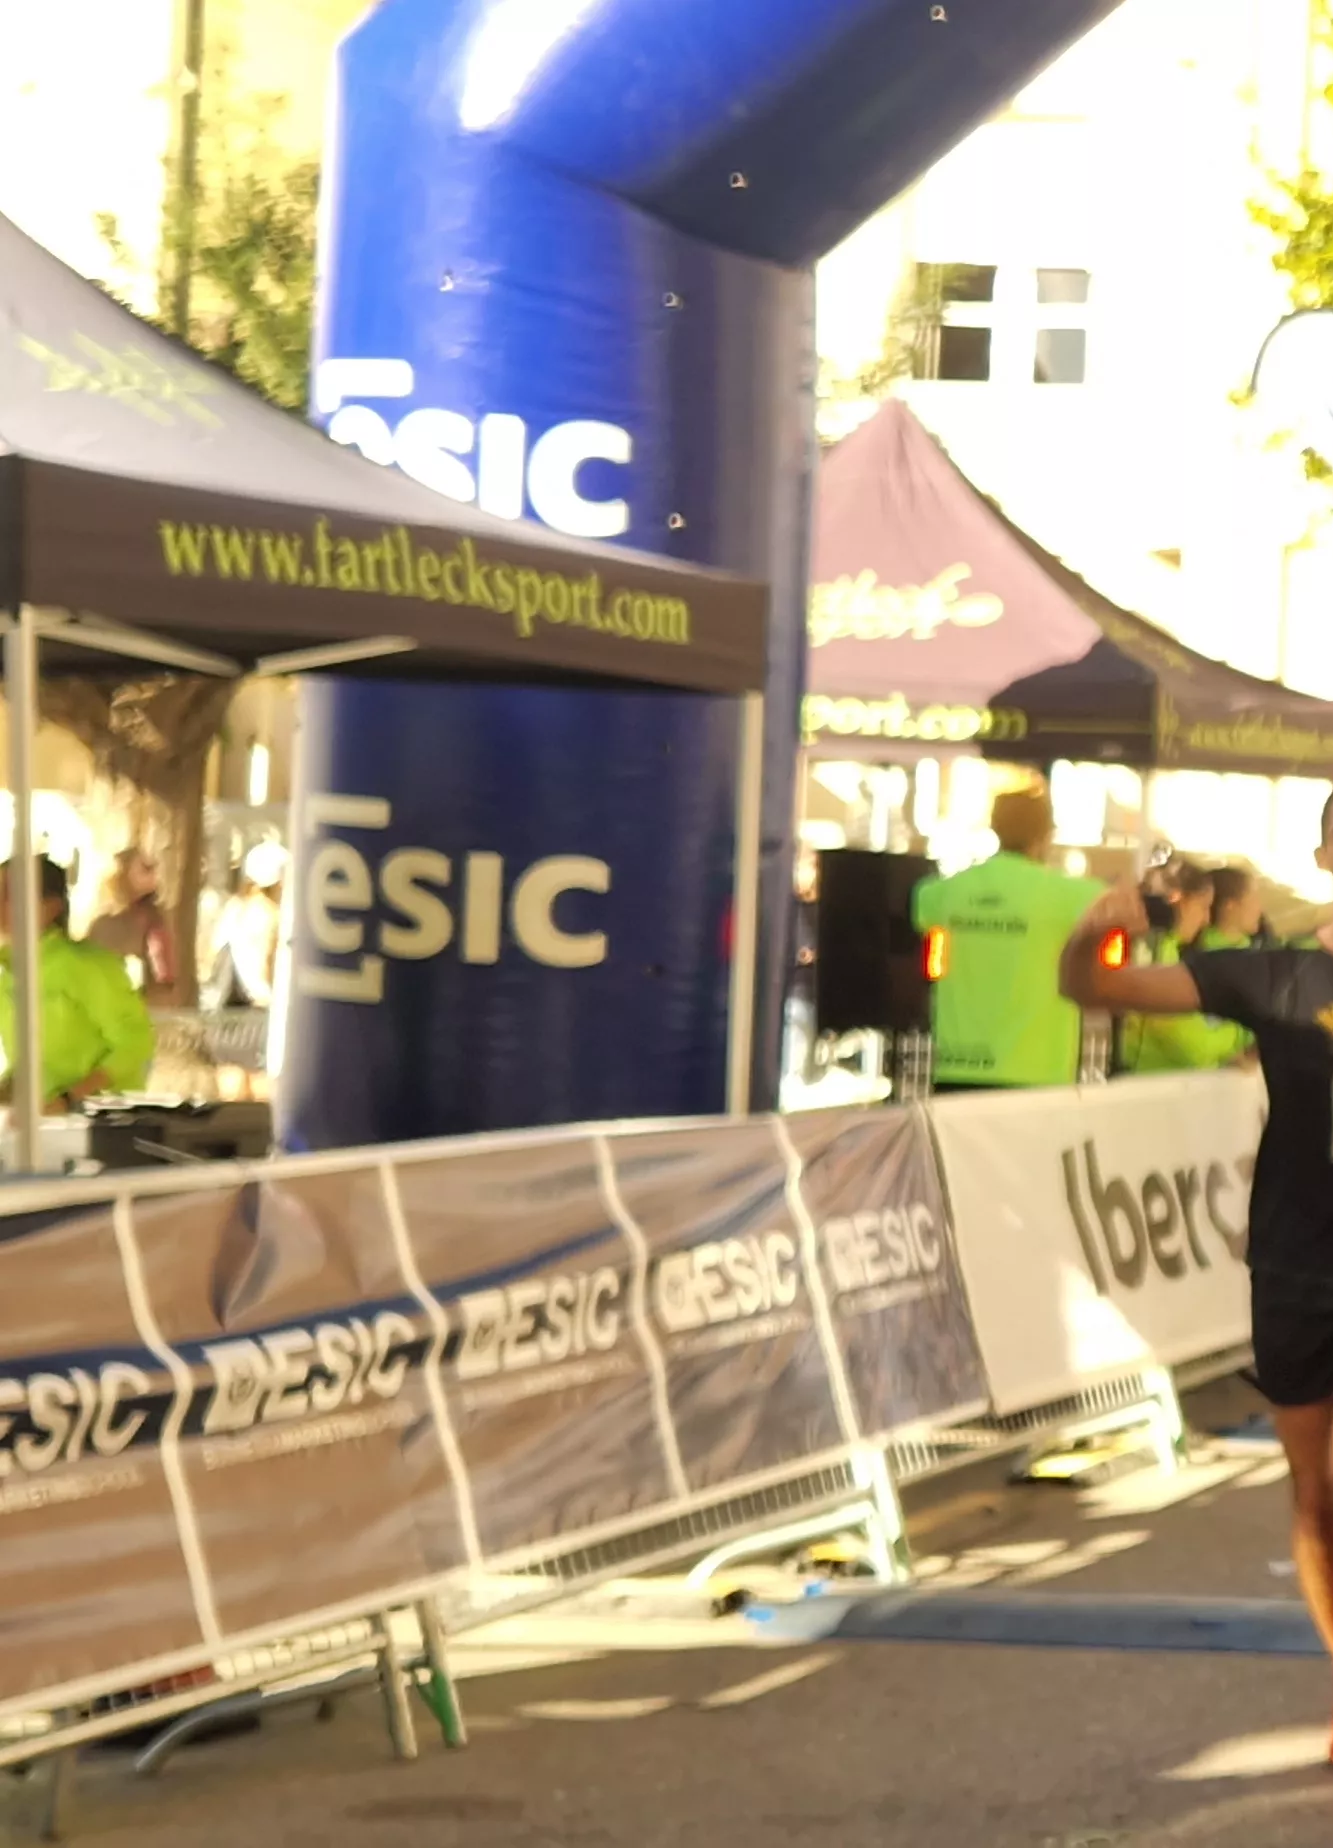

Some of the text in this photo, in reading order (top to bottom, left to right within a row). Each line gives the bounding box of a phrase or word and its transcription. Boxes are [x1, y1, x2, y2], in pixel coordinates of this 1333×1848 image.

[159, 515, 690, 644] www.fartlecksport.com
[504, 1265, 620, 1370] ESIC
[697, 1230, 798, 1325] ESIC
[256, 1317, 418, 1426] ESIC
